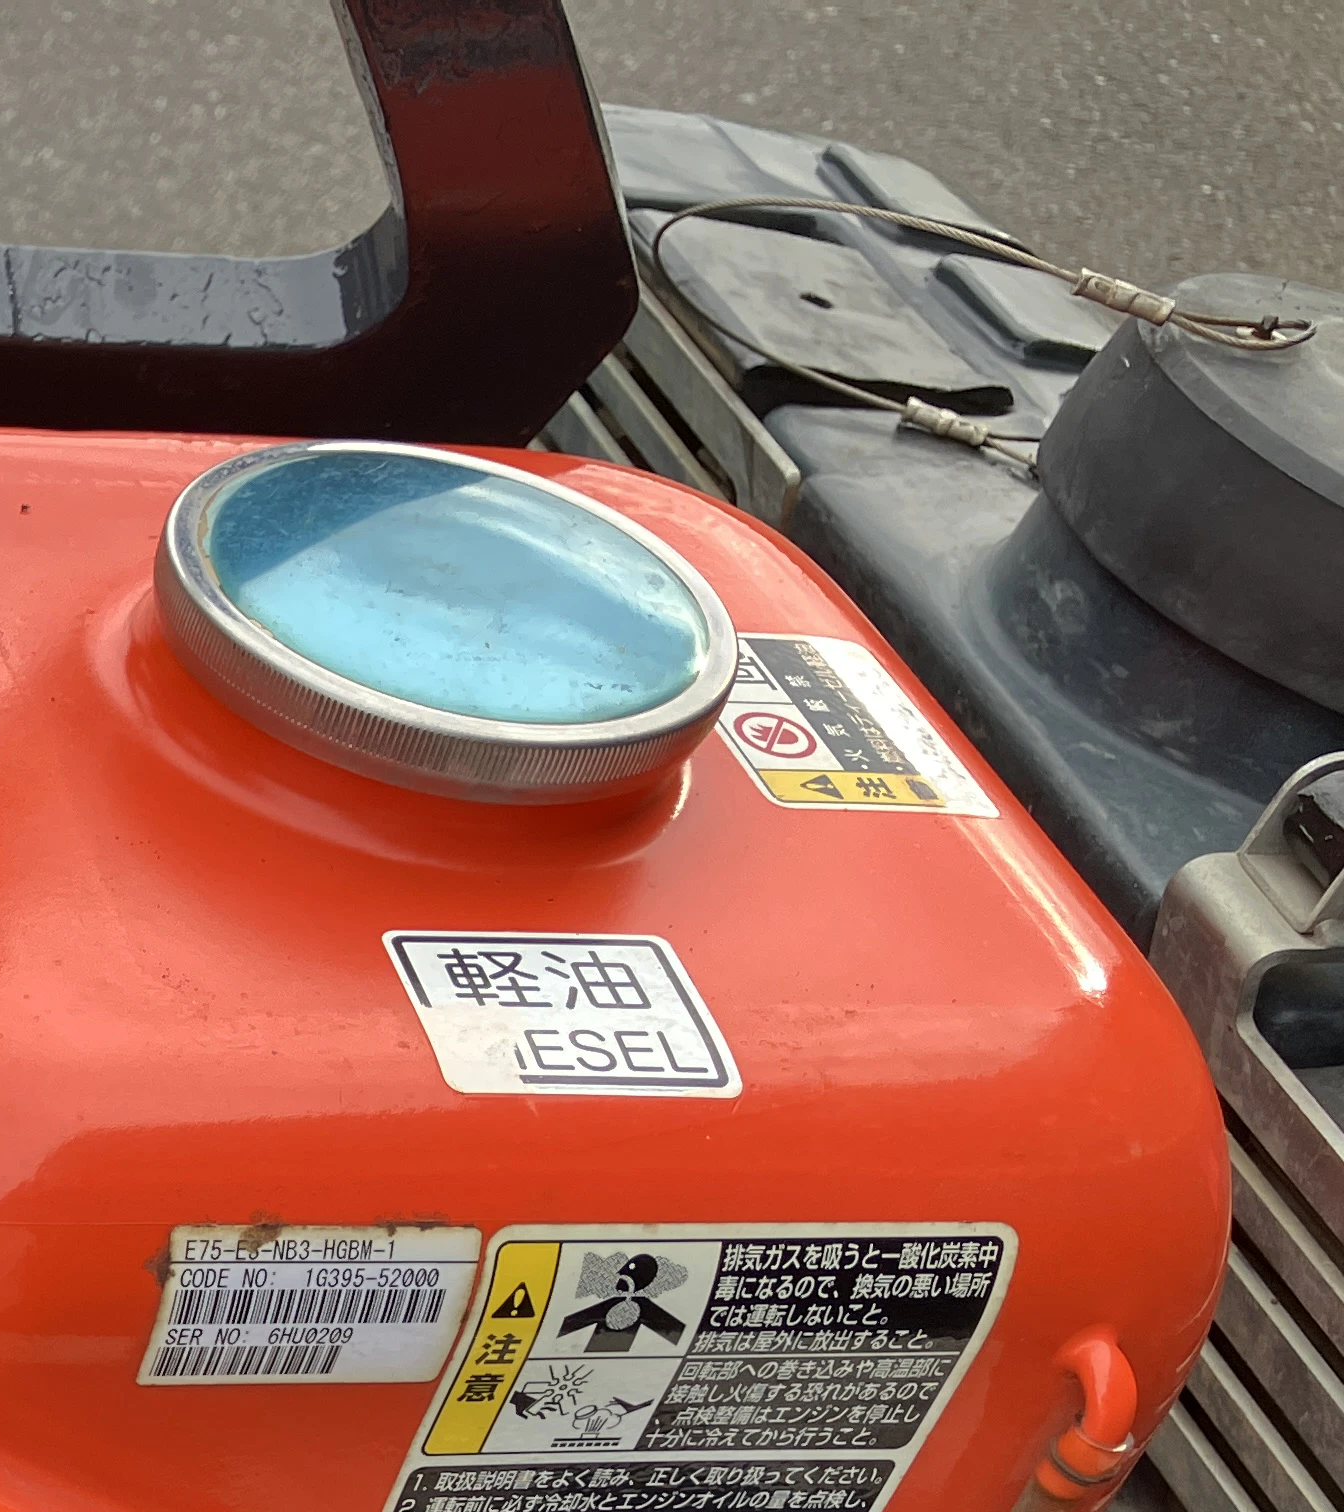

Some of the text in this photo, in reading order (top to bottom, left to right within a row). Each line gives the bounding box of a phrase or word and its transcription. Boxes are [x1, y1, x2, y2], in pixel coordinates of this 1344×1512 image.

[437, 947, 652, 1009] 軽油
[184, 1240, 395, 1260] E75-E3-NB3-HGBM-1
[723, 1242, 999, 1273] 排気ガスを吸うと一酸化炭素中
[180, 1268, 440, 1288] CODE NO: 1G395-52000
[714, 1272, 991, 1302] 毒になるので、換気の悪い場所
[707, 1302, 893, 1329] では運転しないこと。
[164, 1327, 354, 1346] SER NO: 6HU0209
[694, 1328, 937, 1354] 排気は屋外に放出すること。
[456, 1333, 517, 1404] 注意
[678, 1355, 952, 1381] 回転部への巻き込みや高温部に
[667, 1378, 939, 1404] 接触し火傷する恐れがあるので
[643, 1425, 878, 1450] 十分に冷えてから行うこと。
